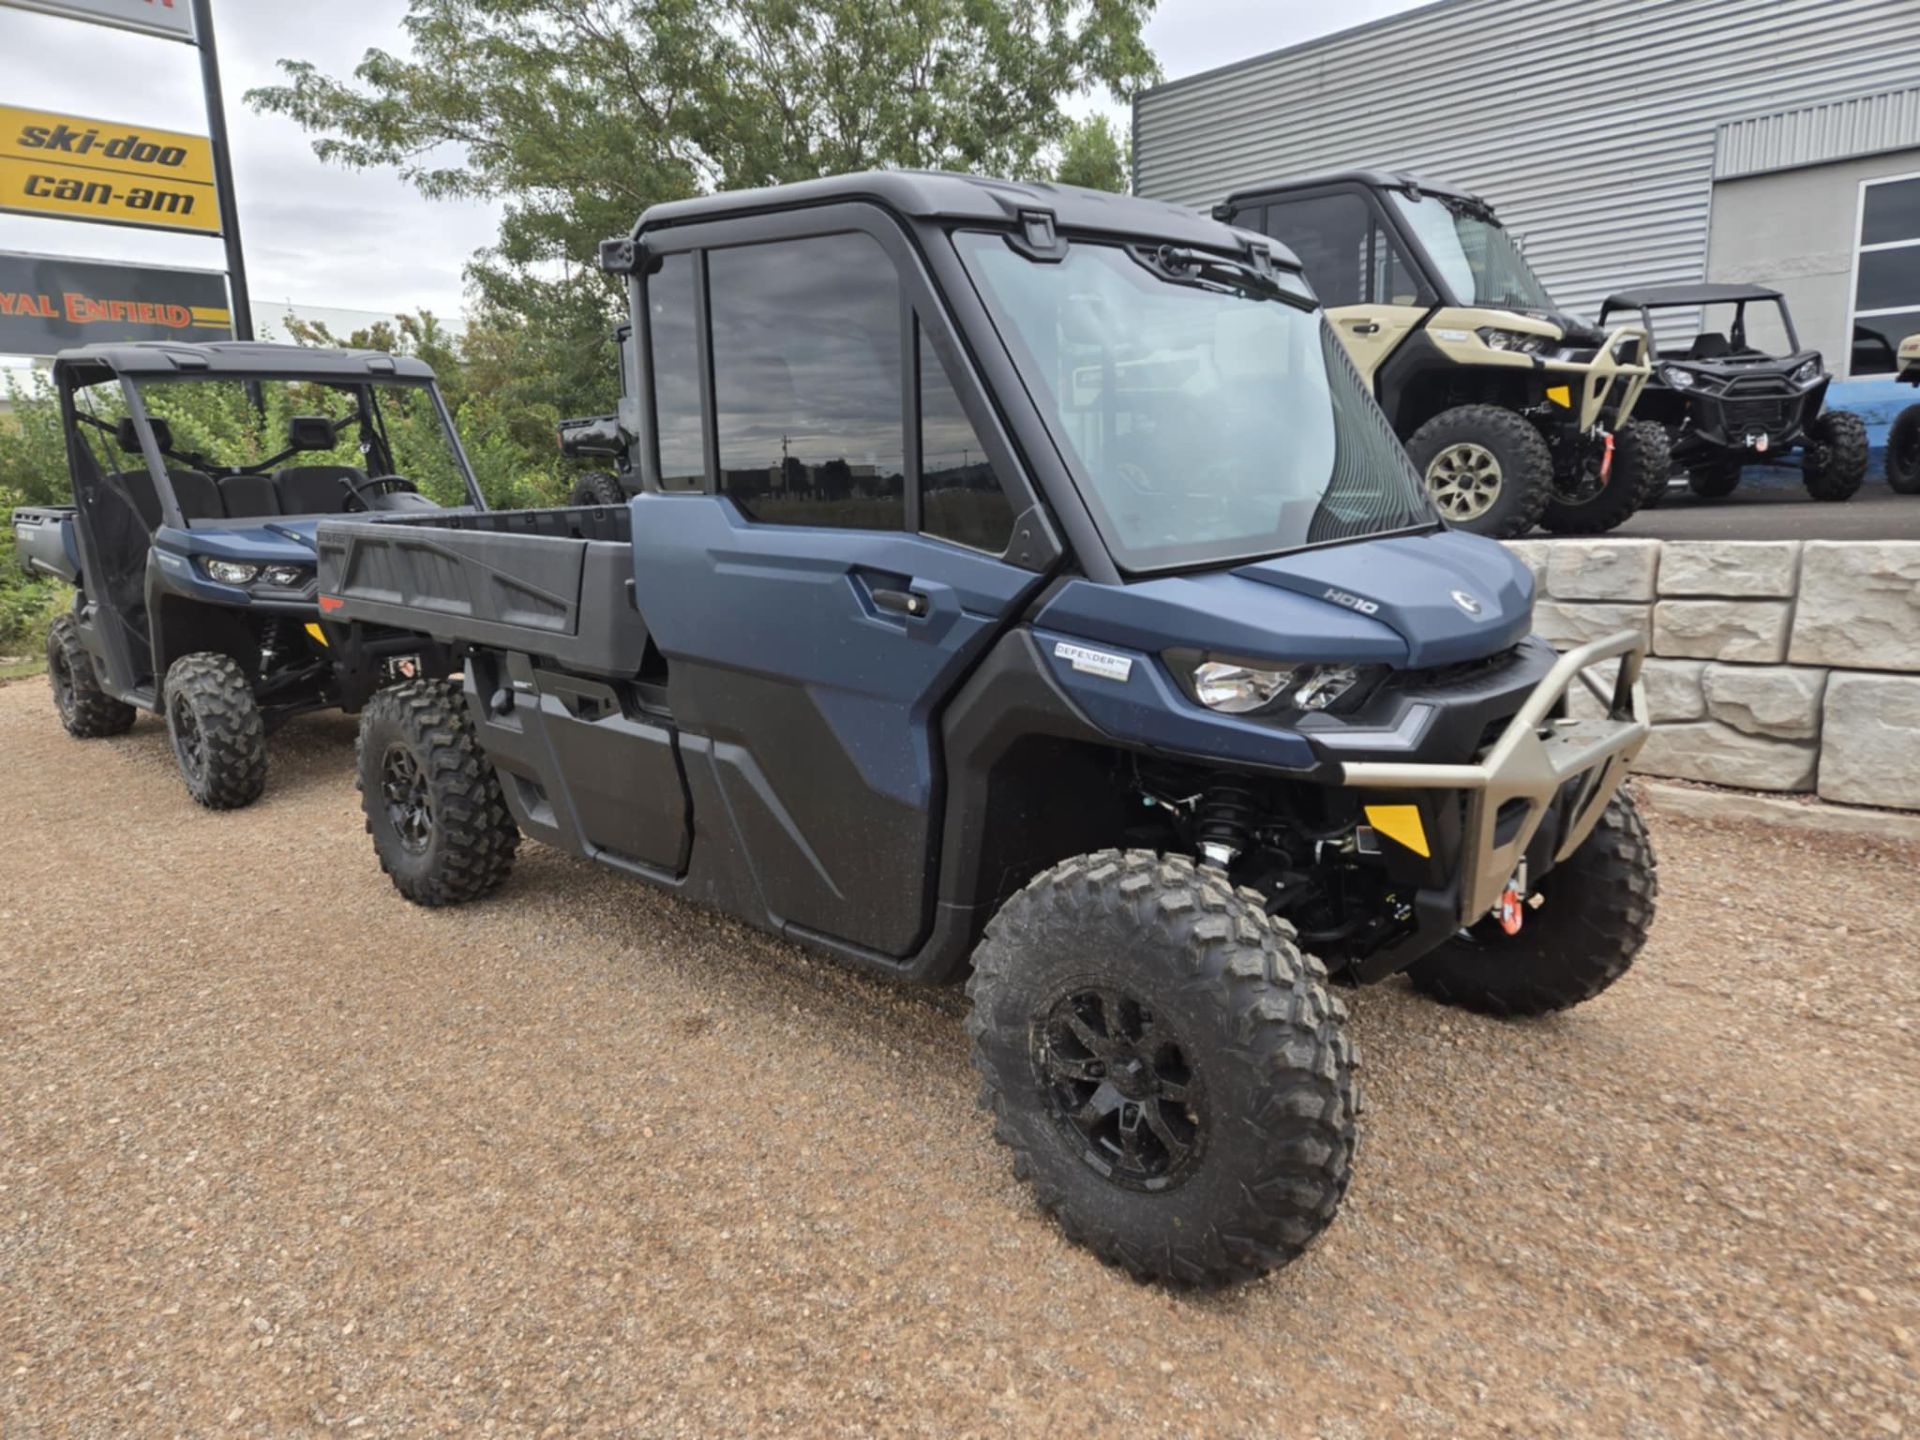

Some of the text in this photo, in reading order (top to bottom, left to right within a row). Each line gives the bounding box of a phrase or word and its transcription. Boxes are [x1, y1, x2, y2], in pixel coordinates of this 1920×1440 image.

[17, 124, 187, 167] ski-doo
[24, 174, 195, 215] can-am
[63, 292, 192, 328] ENFIELD
[1323, 588, 1379, 615] HD10
[1056, 645, 1115, 665] DEFENDER
